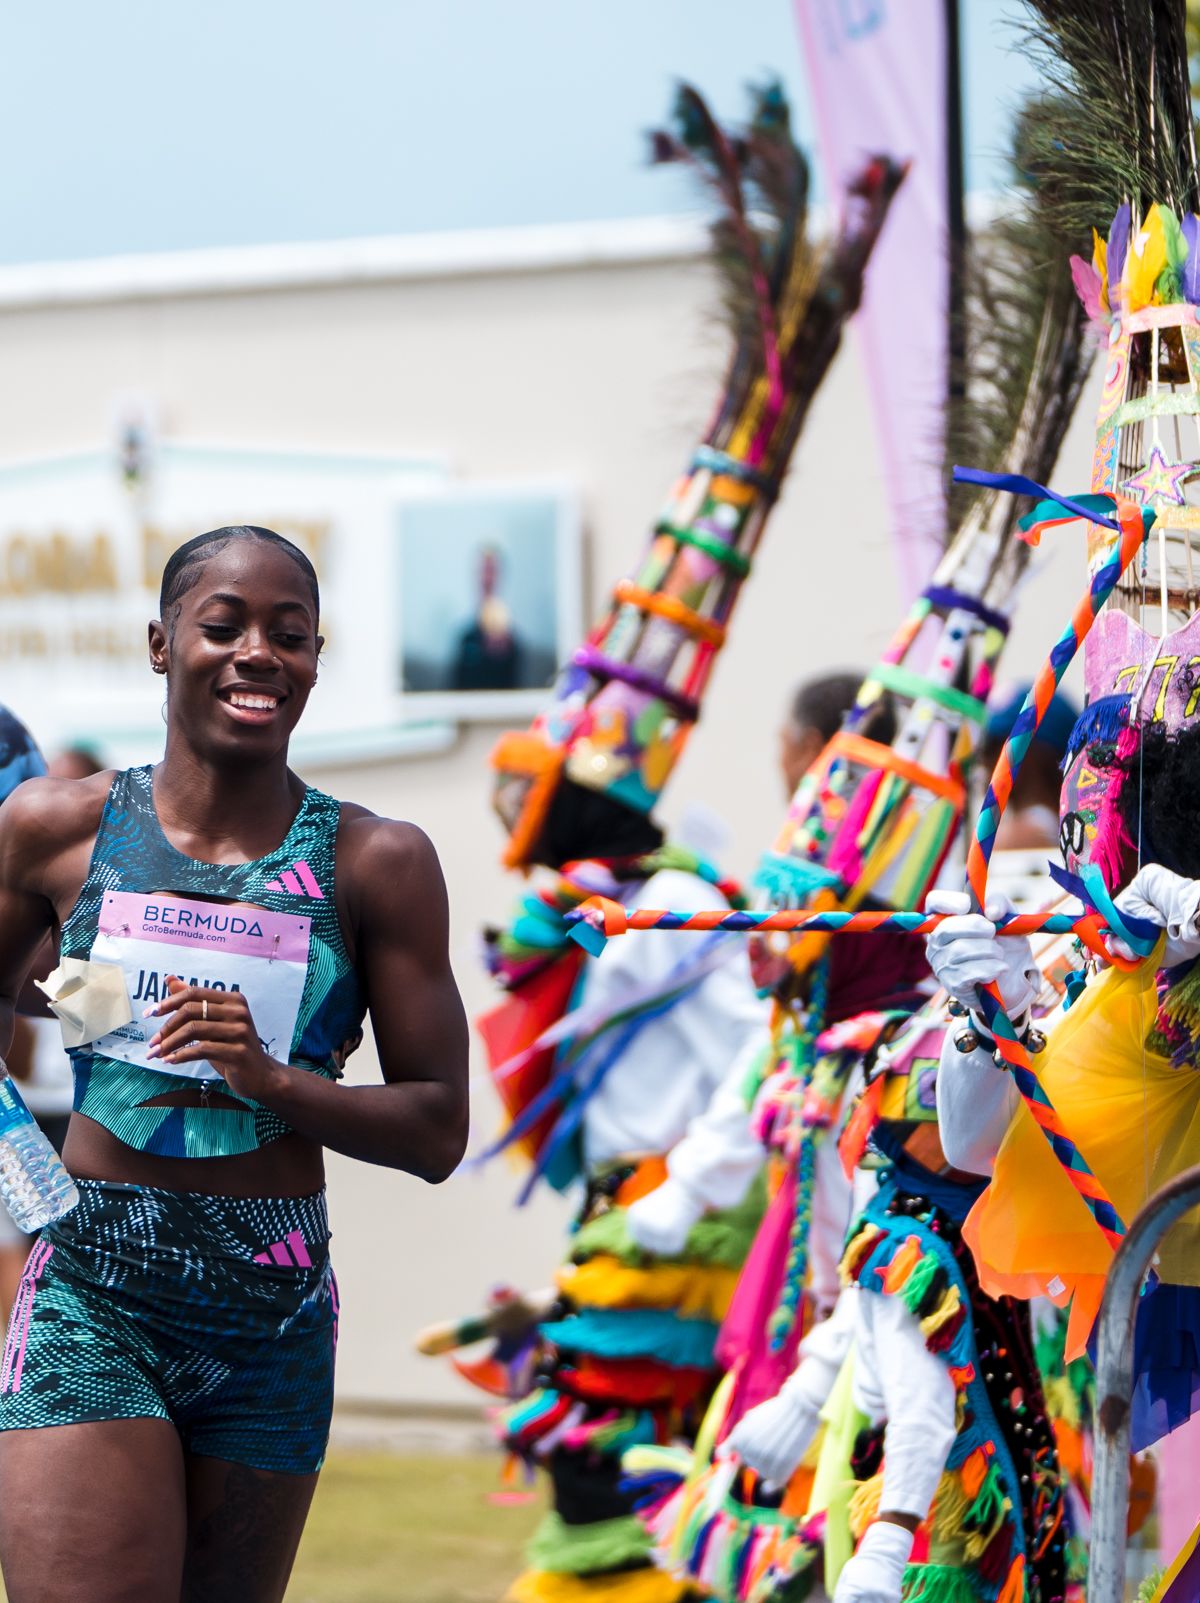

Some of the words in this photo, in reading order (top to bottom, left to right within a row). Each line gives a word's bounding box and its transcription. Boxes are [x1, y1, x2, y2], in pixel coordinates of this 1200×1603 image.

[144, 905, 264, 937] BERMUDA
[142, 923, 226, 943] GoToBermuda.com
[110, 1030, 128, 1038] RAND
